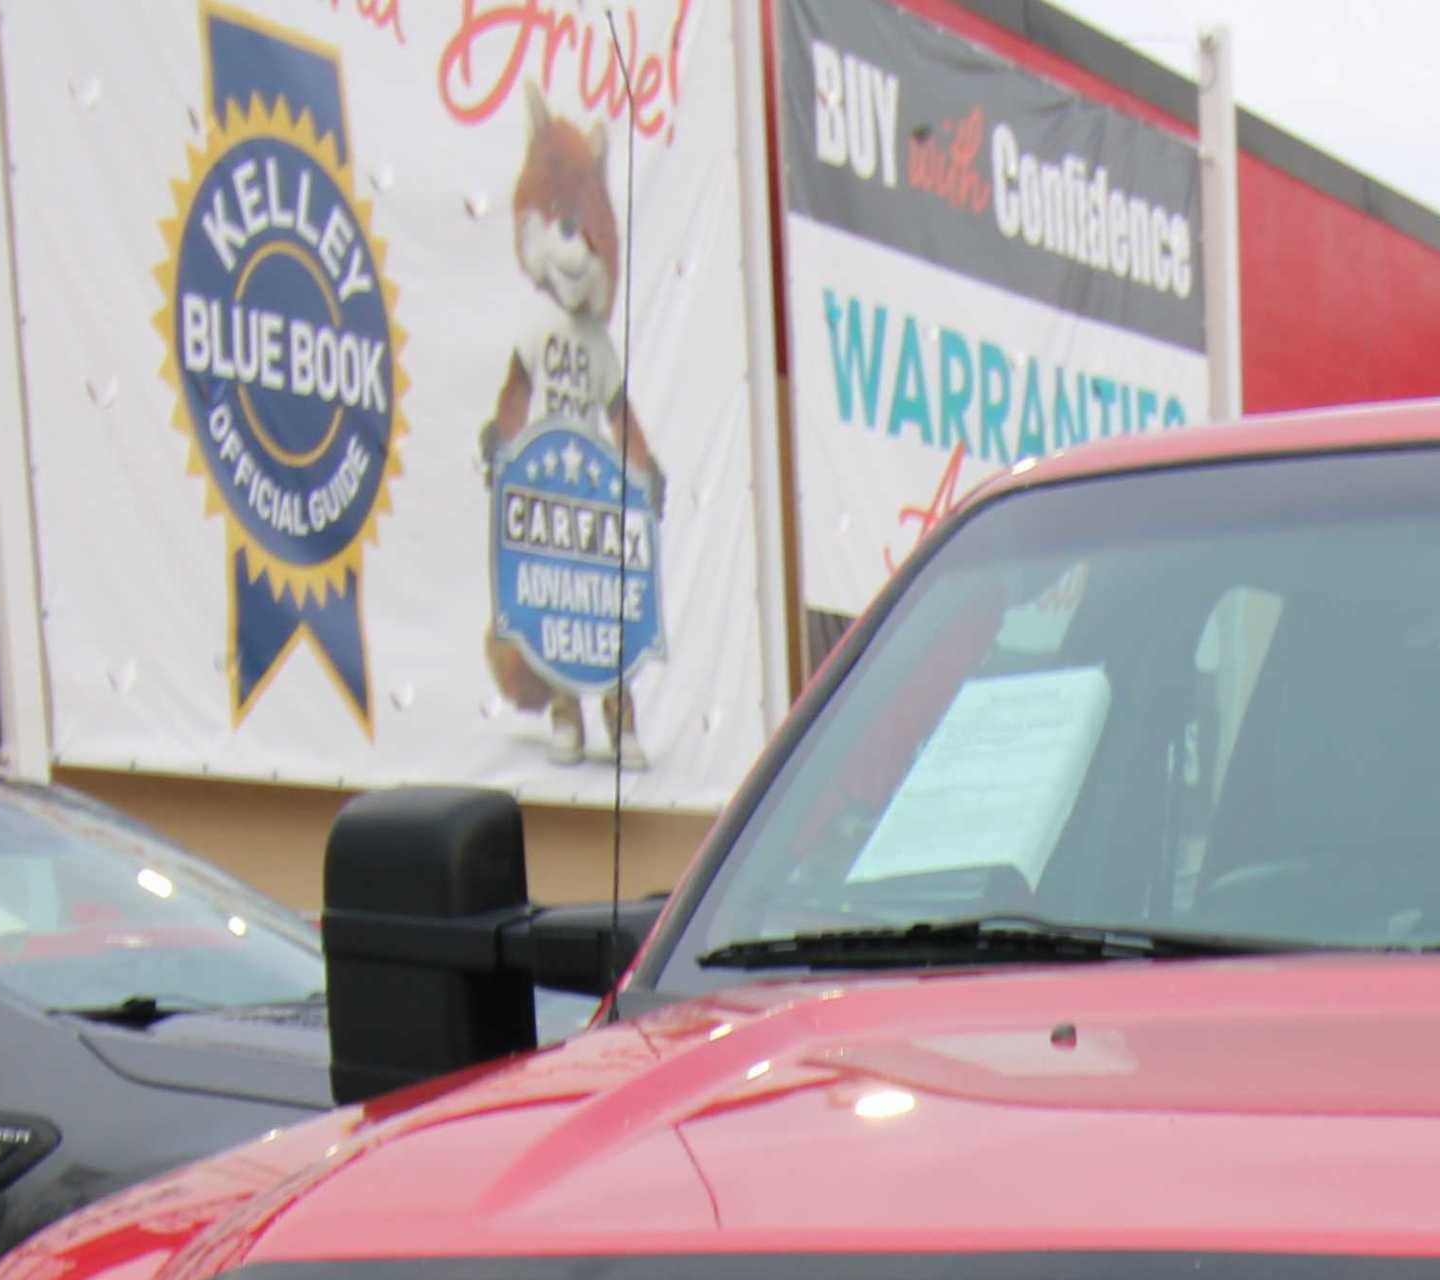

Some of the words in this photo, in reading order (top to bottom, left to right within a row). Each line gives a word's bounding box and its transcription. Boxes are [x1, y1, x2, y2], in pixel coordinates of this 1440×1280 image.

[201, 156, 372, 302] KELLEY
[812, 39, 899, 189] BUY
[992, 123, 1192, 299] Confidence
[182, 292, 284, 390] BLUE
[290, 319, 387, 414] BOOK
[544, 335, 590, 390] CAR
[823, 287, 1187, 466] WARRANT
[208, 402, 308, 537] OFFICIAL
[307, 434, 370, 533] GUIDE
[507, 494, 650, 570] CARFAX
